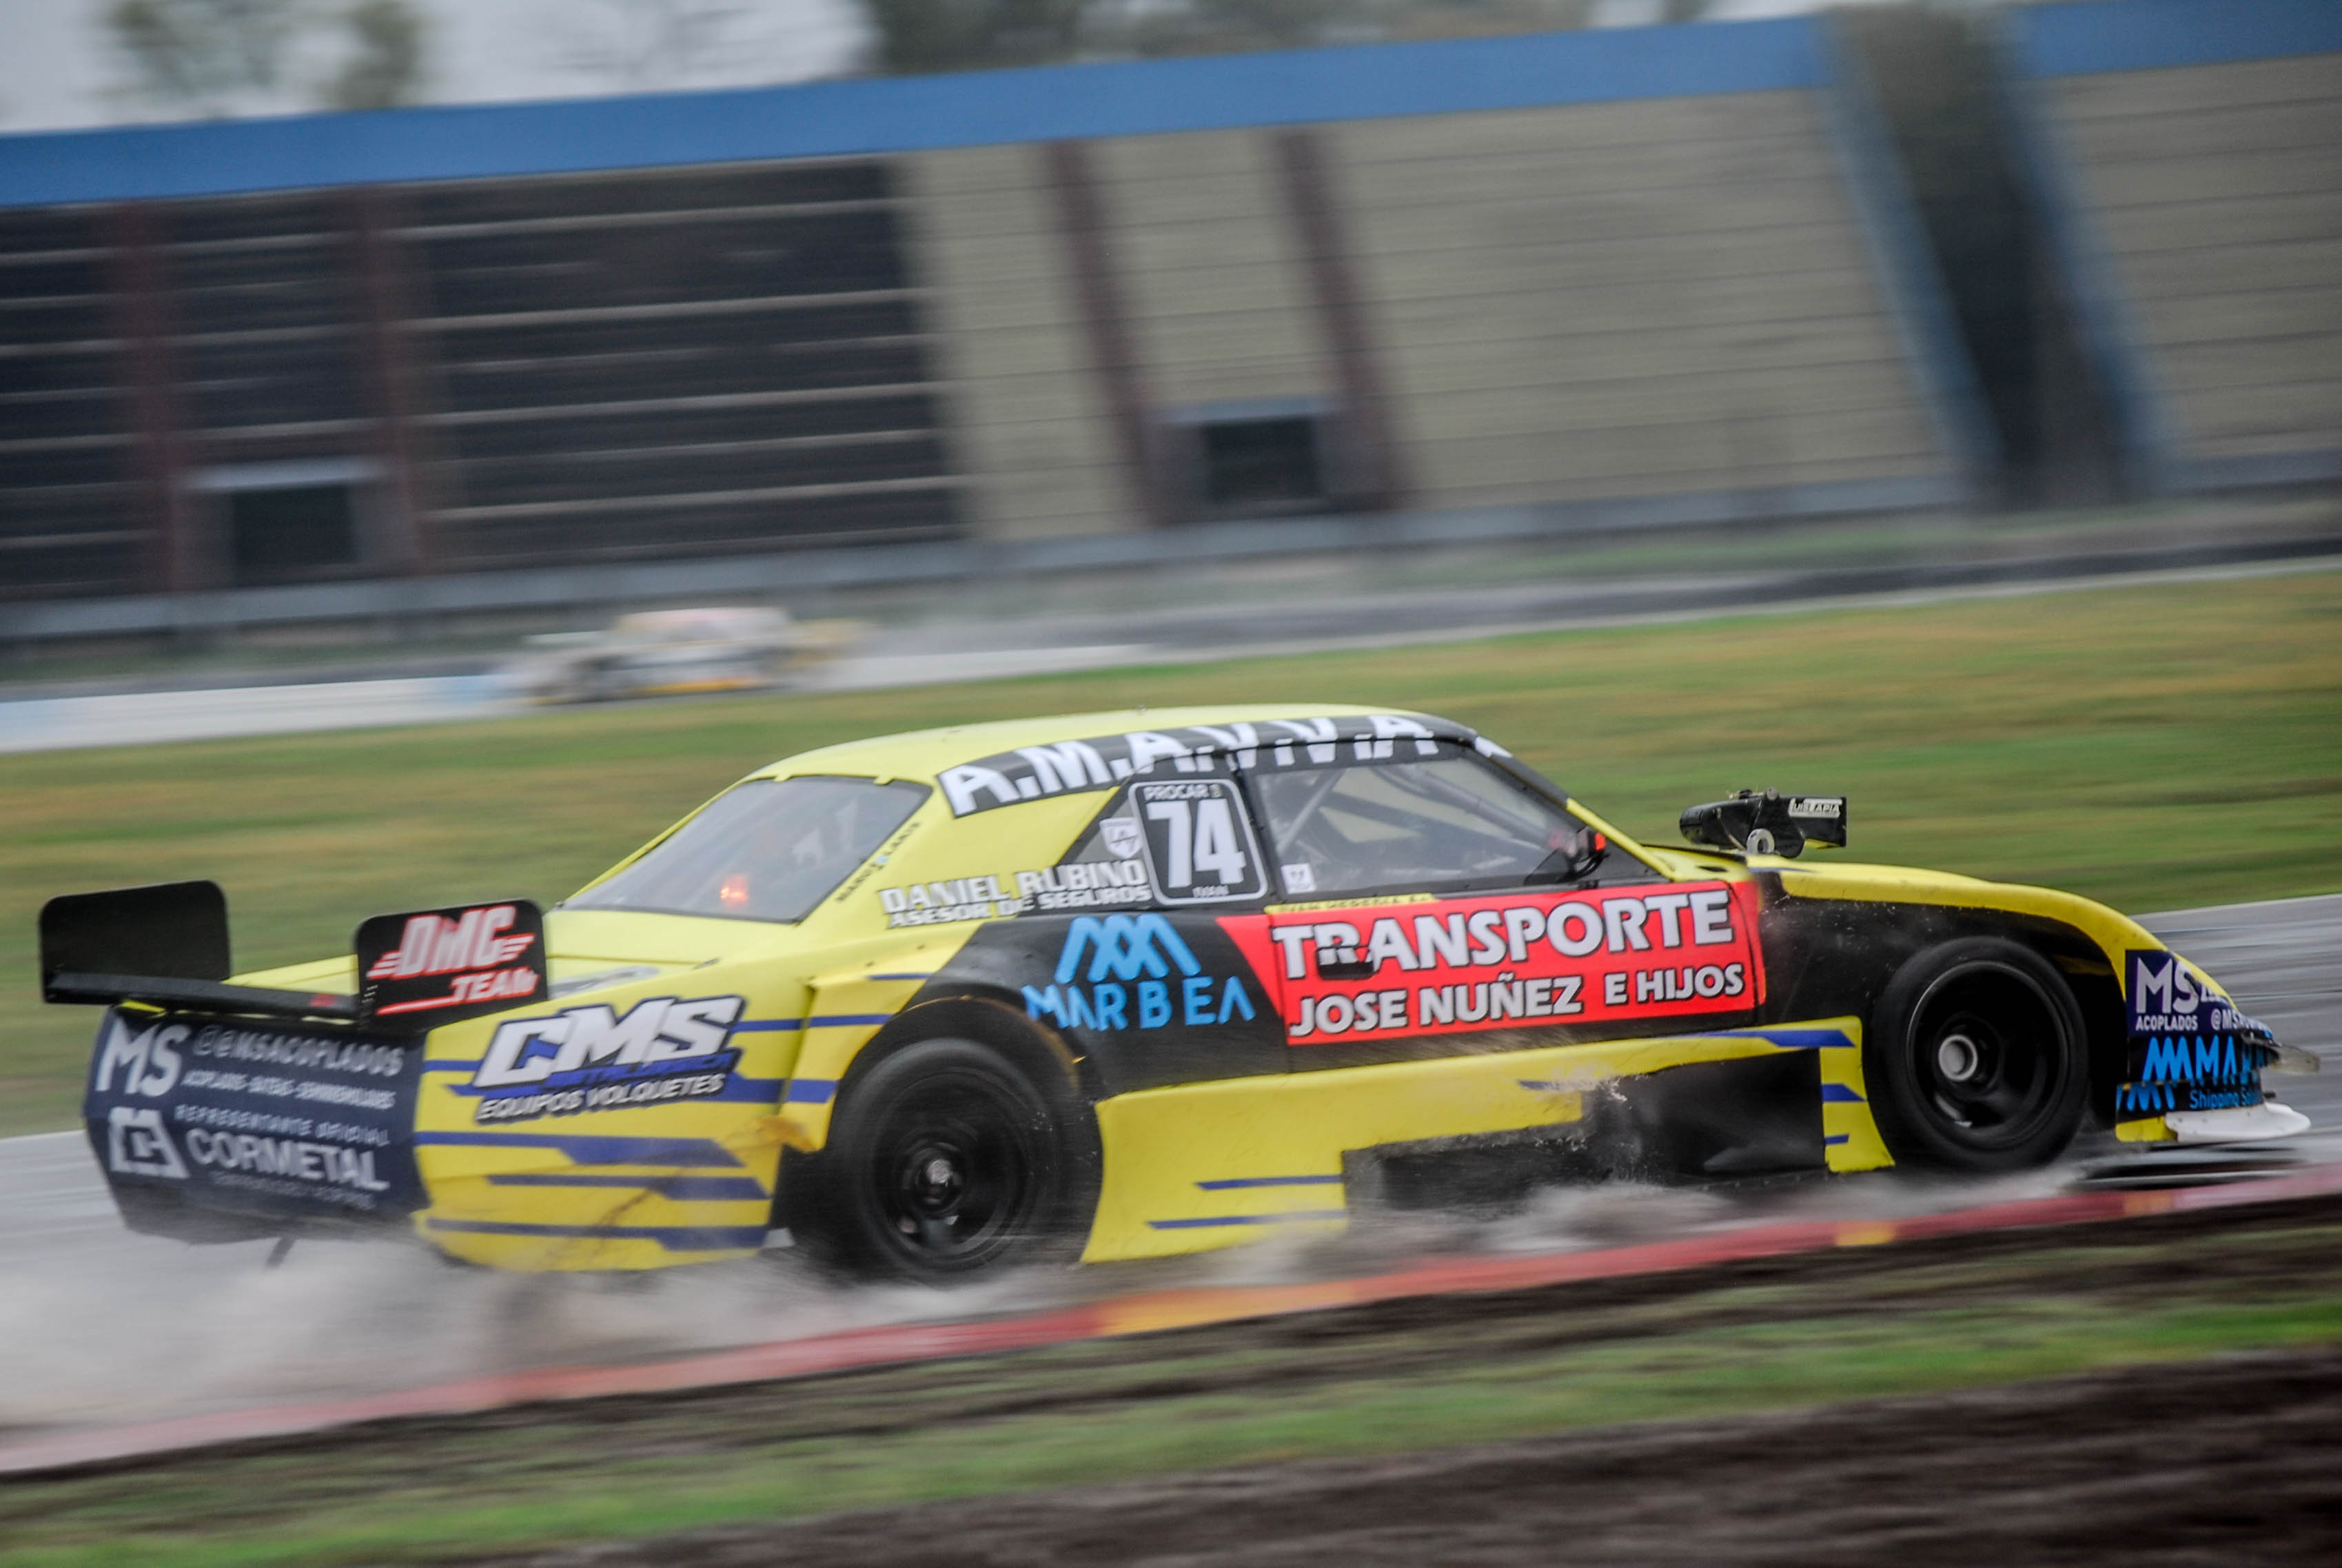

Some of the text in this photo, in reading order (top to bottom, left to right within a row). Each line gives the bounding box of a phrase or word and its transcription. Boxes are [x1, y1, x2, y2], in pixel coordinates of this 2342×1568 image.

[1145, 797, 1247, 888] 74
[878, 857, 1148, 914] DANIEL RUBINO
[888, 883, 1152, 928] ASESOR DE SEGUROS
[1272, 889, 1734, 979] TRANSPORTE
[449, 966, 540, 1001] TEAM
[1020, 975, 1256, 1032] MARBEA
[1290, 963, 1744, 1038] JOSE NUÑEZ E HIJOS
[2135, 955, 2199, 1015] MS
[474, 997, 744, 1088] CMS
[2135, 1015, 2198, 1031] ACOPLADOS
[95, 1020, 191, 1097] MS
[174, 1103, 314, 1136] REPRESENTANTE
[476, 1073, 726, 1121] EQUIPOS VOLQUETES
[2190, 1089, 2240, 1110] Shipping
[185, 1127, 391, 1192] CORMETAL
